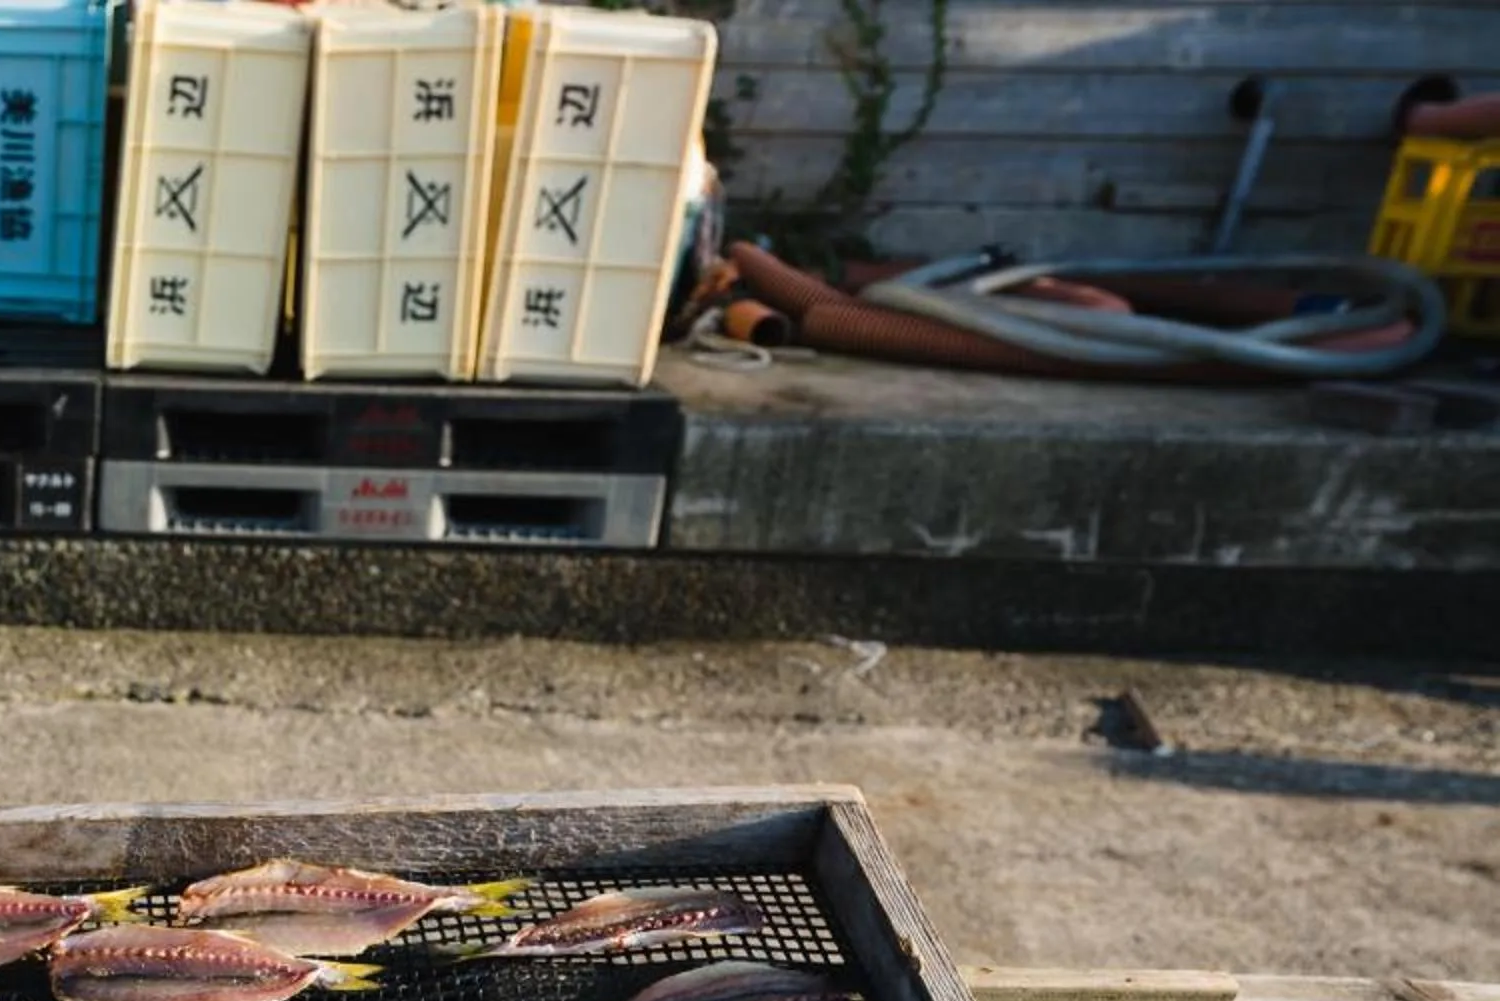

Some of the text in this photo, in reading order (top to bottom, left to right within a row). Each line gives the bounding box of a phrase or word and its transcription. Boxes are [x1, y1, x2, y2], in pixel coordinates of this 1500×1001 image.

[151, 76, 208, 315] 浜 辺
[401, 78, 456, 323] 浜 辺
[521, 84, 600, 328] 浜 辺
